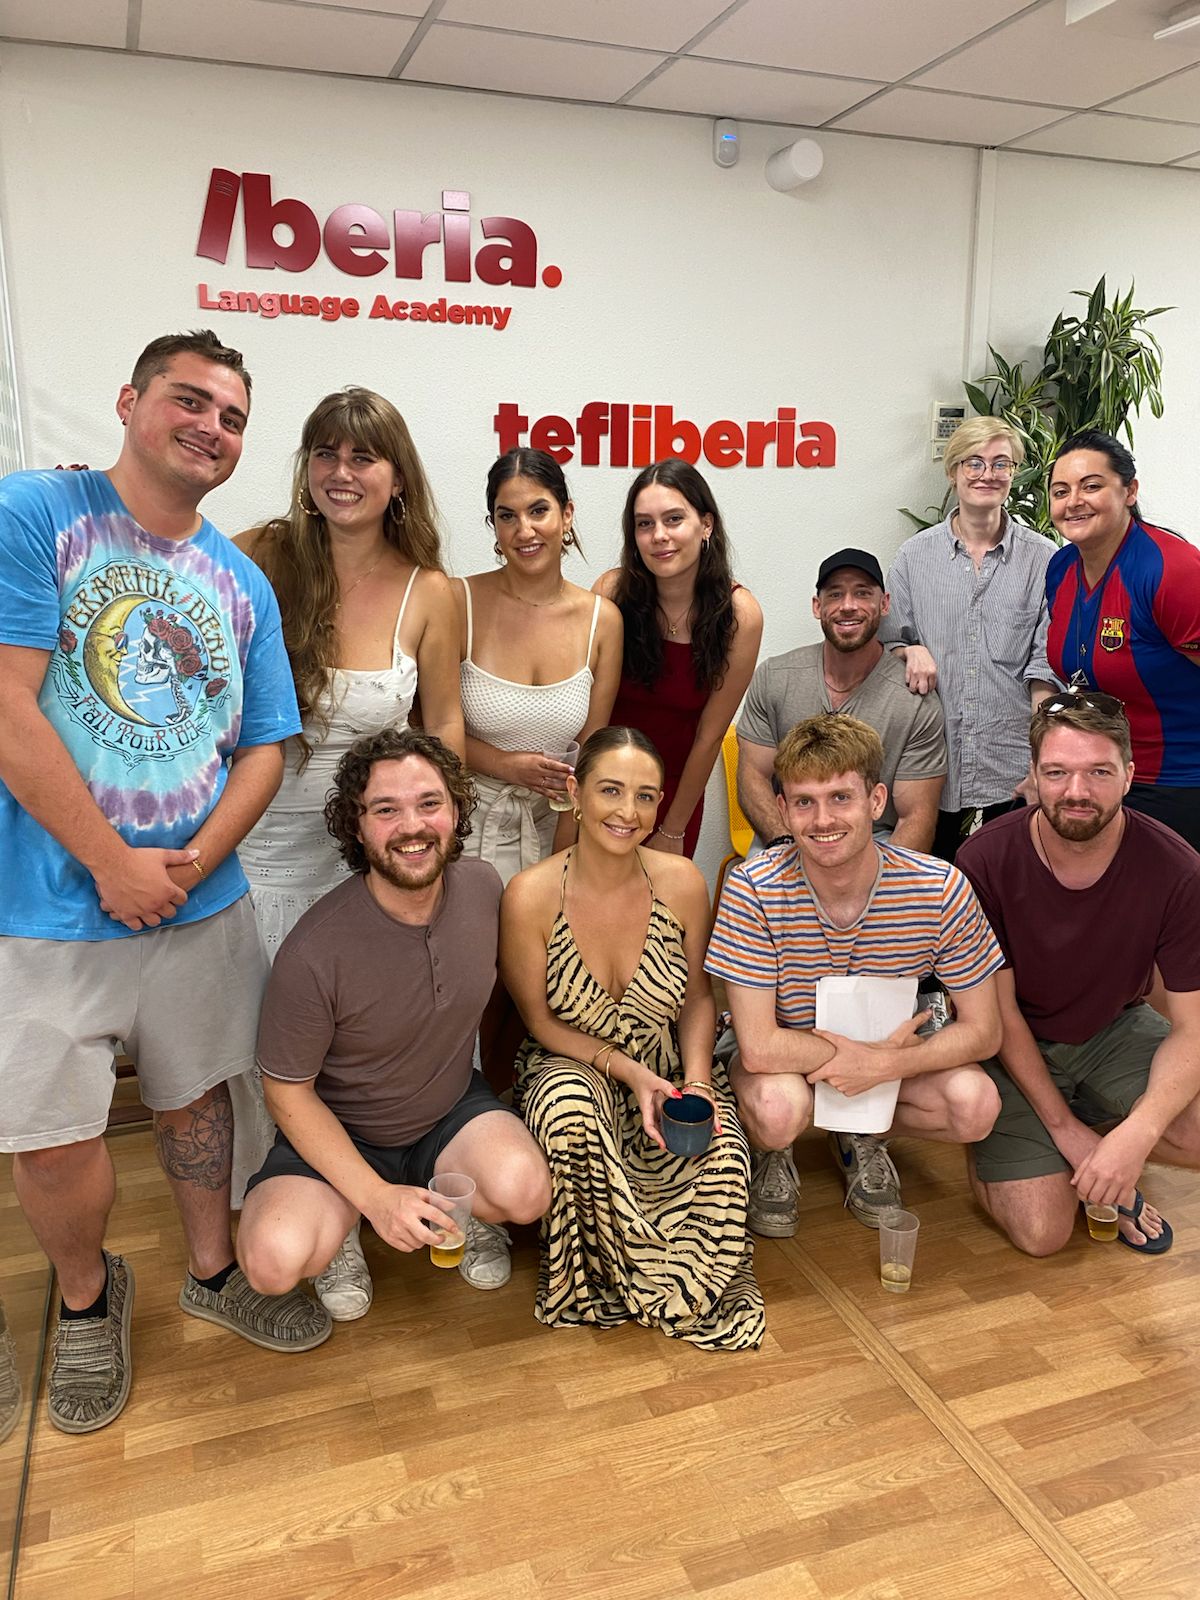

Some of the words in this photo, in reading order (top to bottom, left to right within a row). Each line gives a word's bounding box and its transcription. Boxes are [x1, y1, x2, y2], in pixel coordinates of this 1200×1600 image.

[198, 283, 359, 321] Language
[369, 294, 512, 330] Academy
[494, 401, 836, 468] tefliberia
[68, 566, 178, 630] GRATEFUL
[187, 598, 230, 673] DEAD
